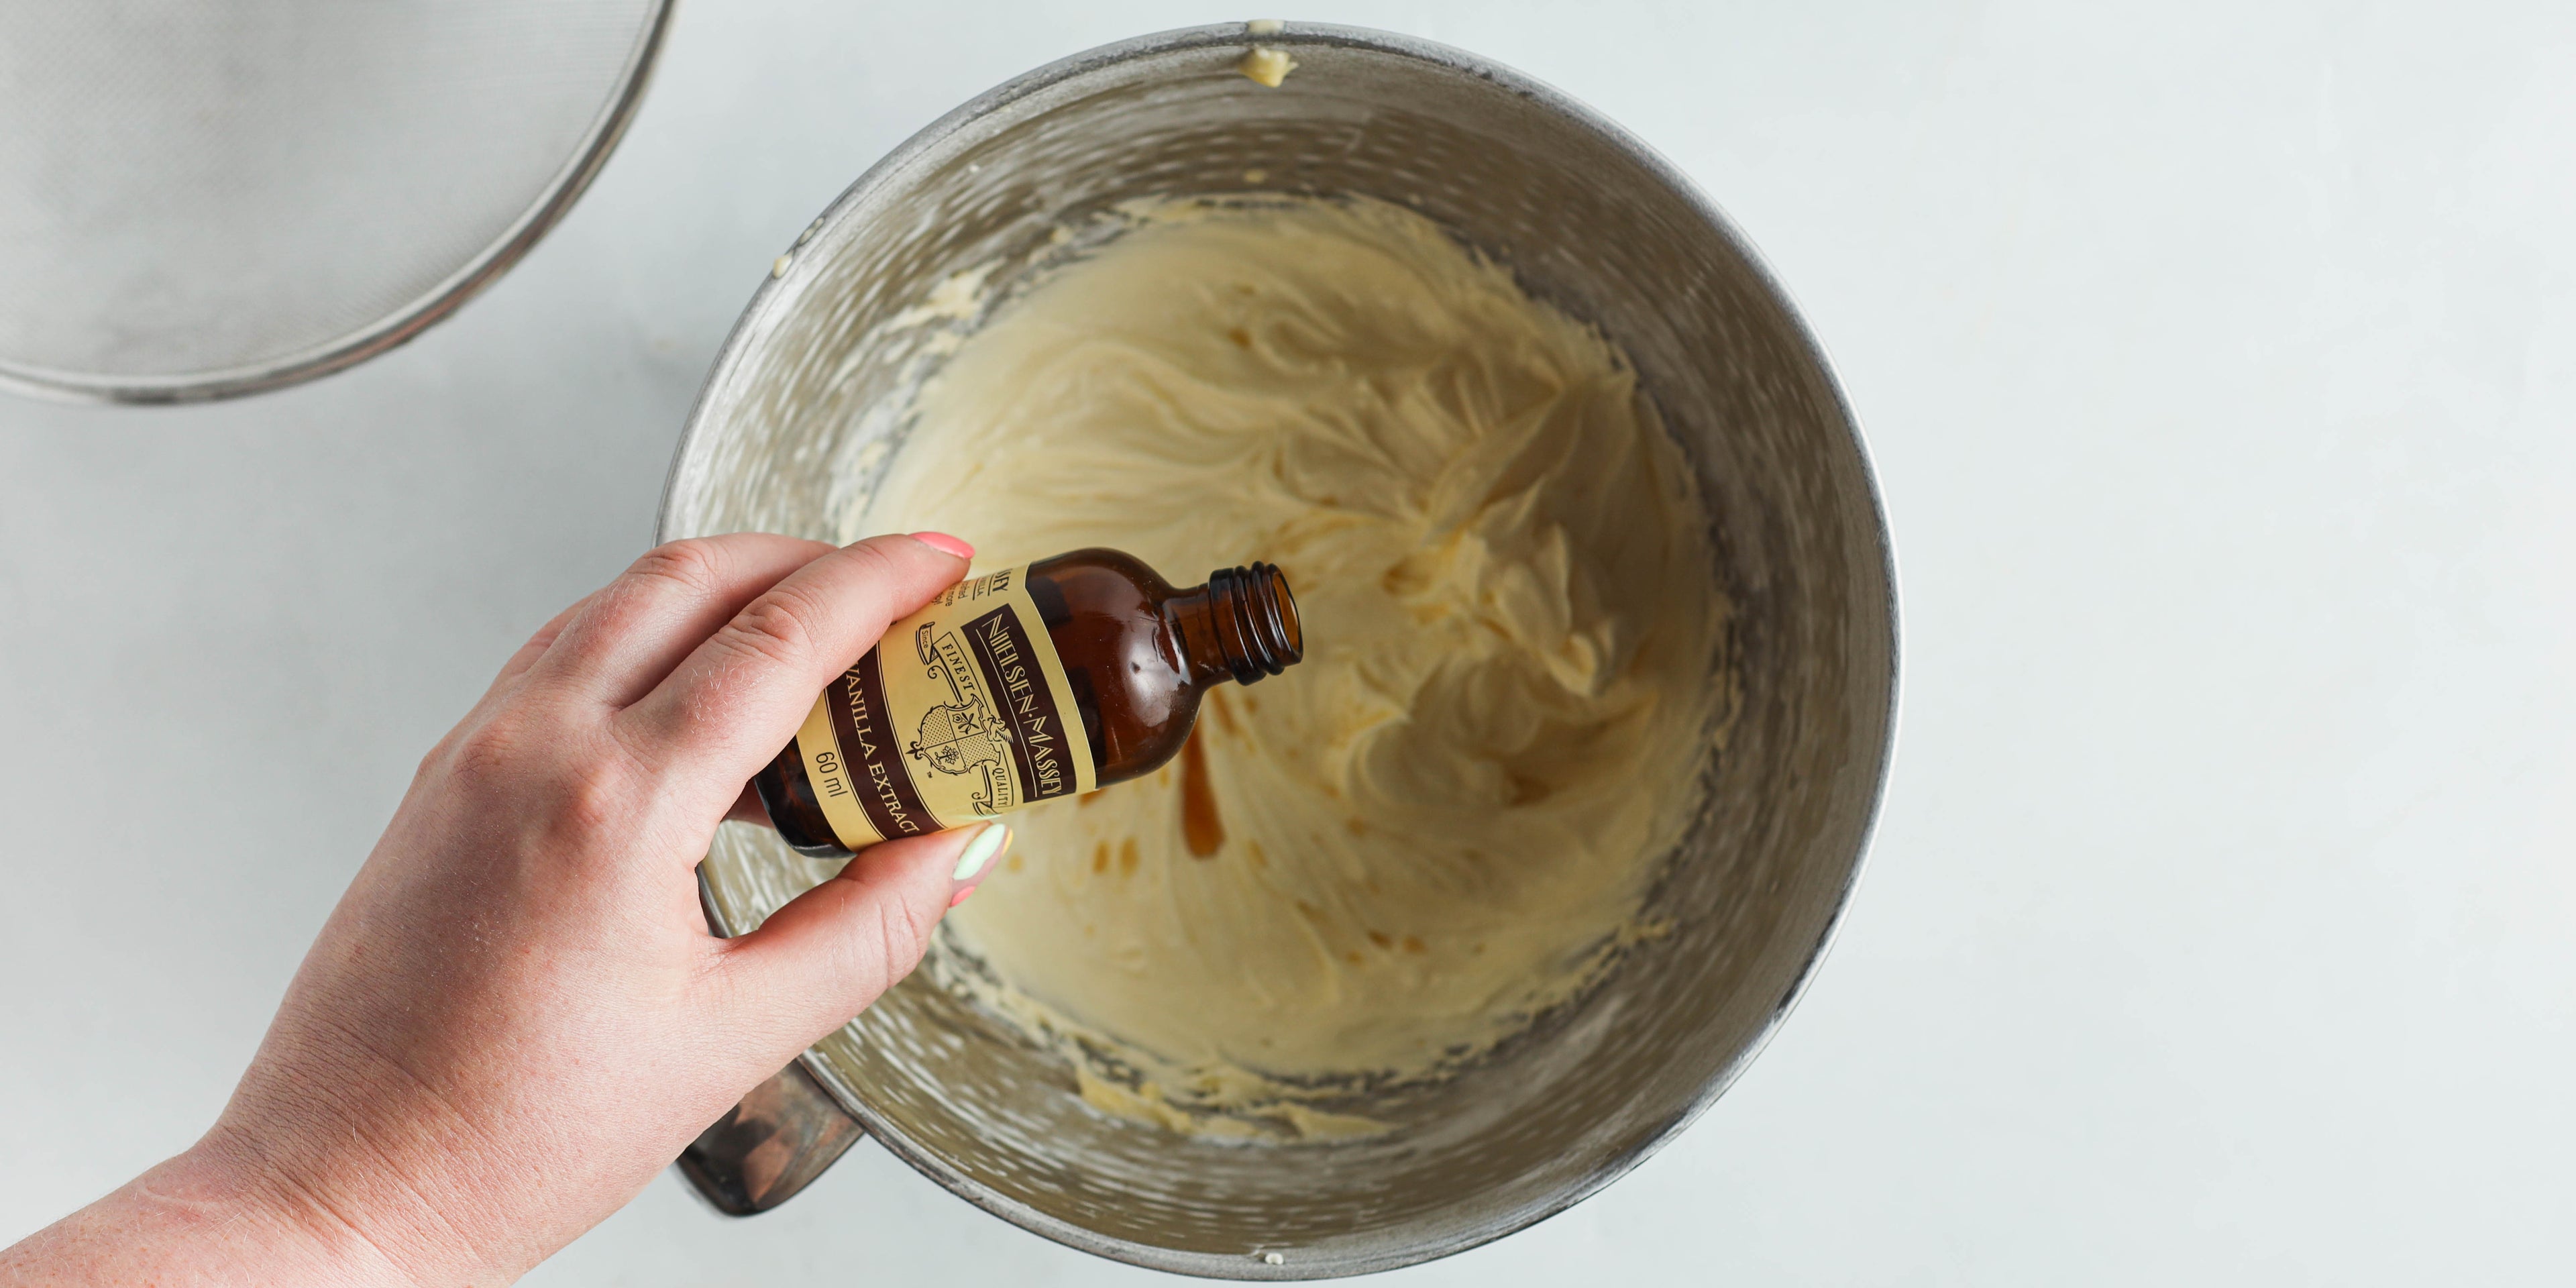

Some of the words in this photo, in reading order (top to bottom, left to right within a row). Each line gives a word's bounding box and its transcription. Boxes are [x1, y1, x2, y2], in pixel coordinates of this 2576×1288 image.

[942, 643, 975, 690] FINEST
[816, 751, 839, 773] 60
[845, 661, 877, 760] VANILLA
[868, 761, 920, 833] EXTRACT
[824, 777, 849, 798] ml
[992, 767, 1008, 806] QUALITY
